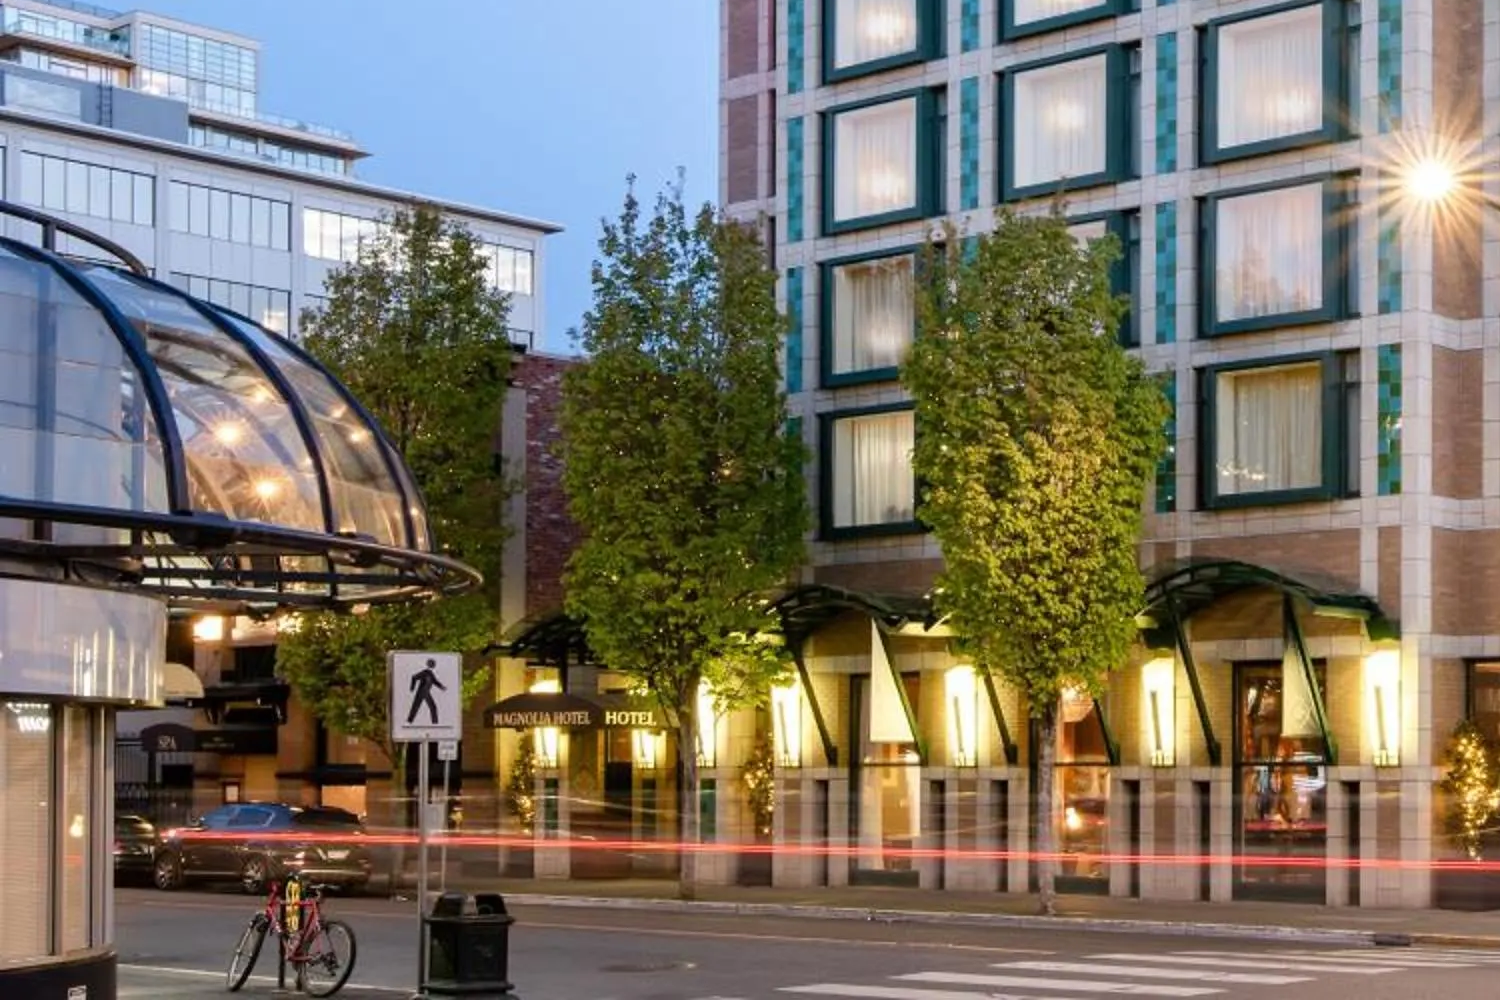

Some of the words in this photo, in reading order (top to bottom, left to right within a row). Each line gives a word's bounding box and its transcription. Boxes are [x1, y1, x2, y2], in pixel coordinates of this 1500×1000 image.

[493, 711, 550, 725] MAGNOLIA
[553, 711, 591, 725] HOTEL
[605, 711, 657, 725] HOTEL
[158, 735, 177, 750] SPA
